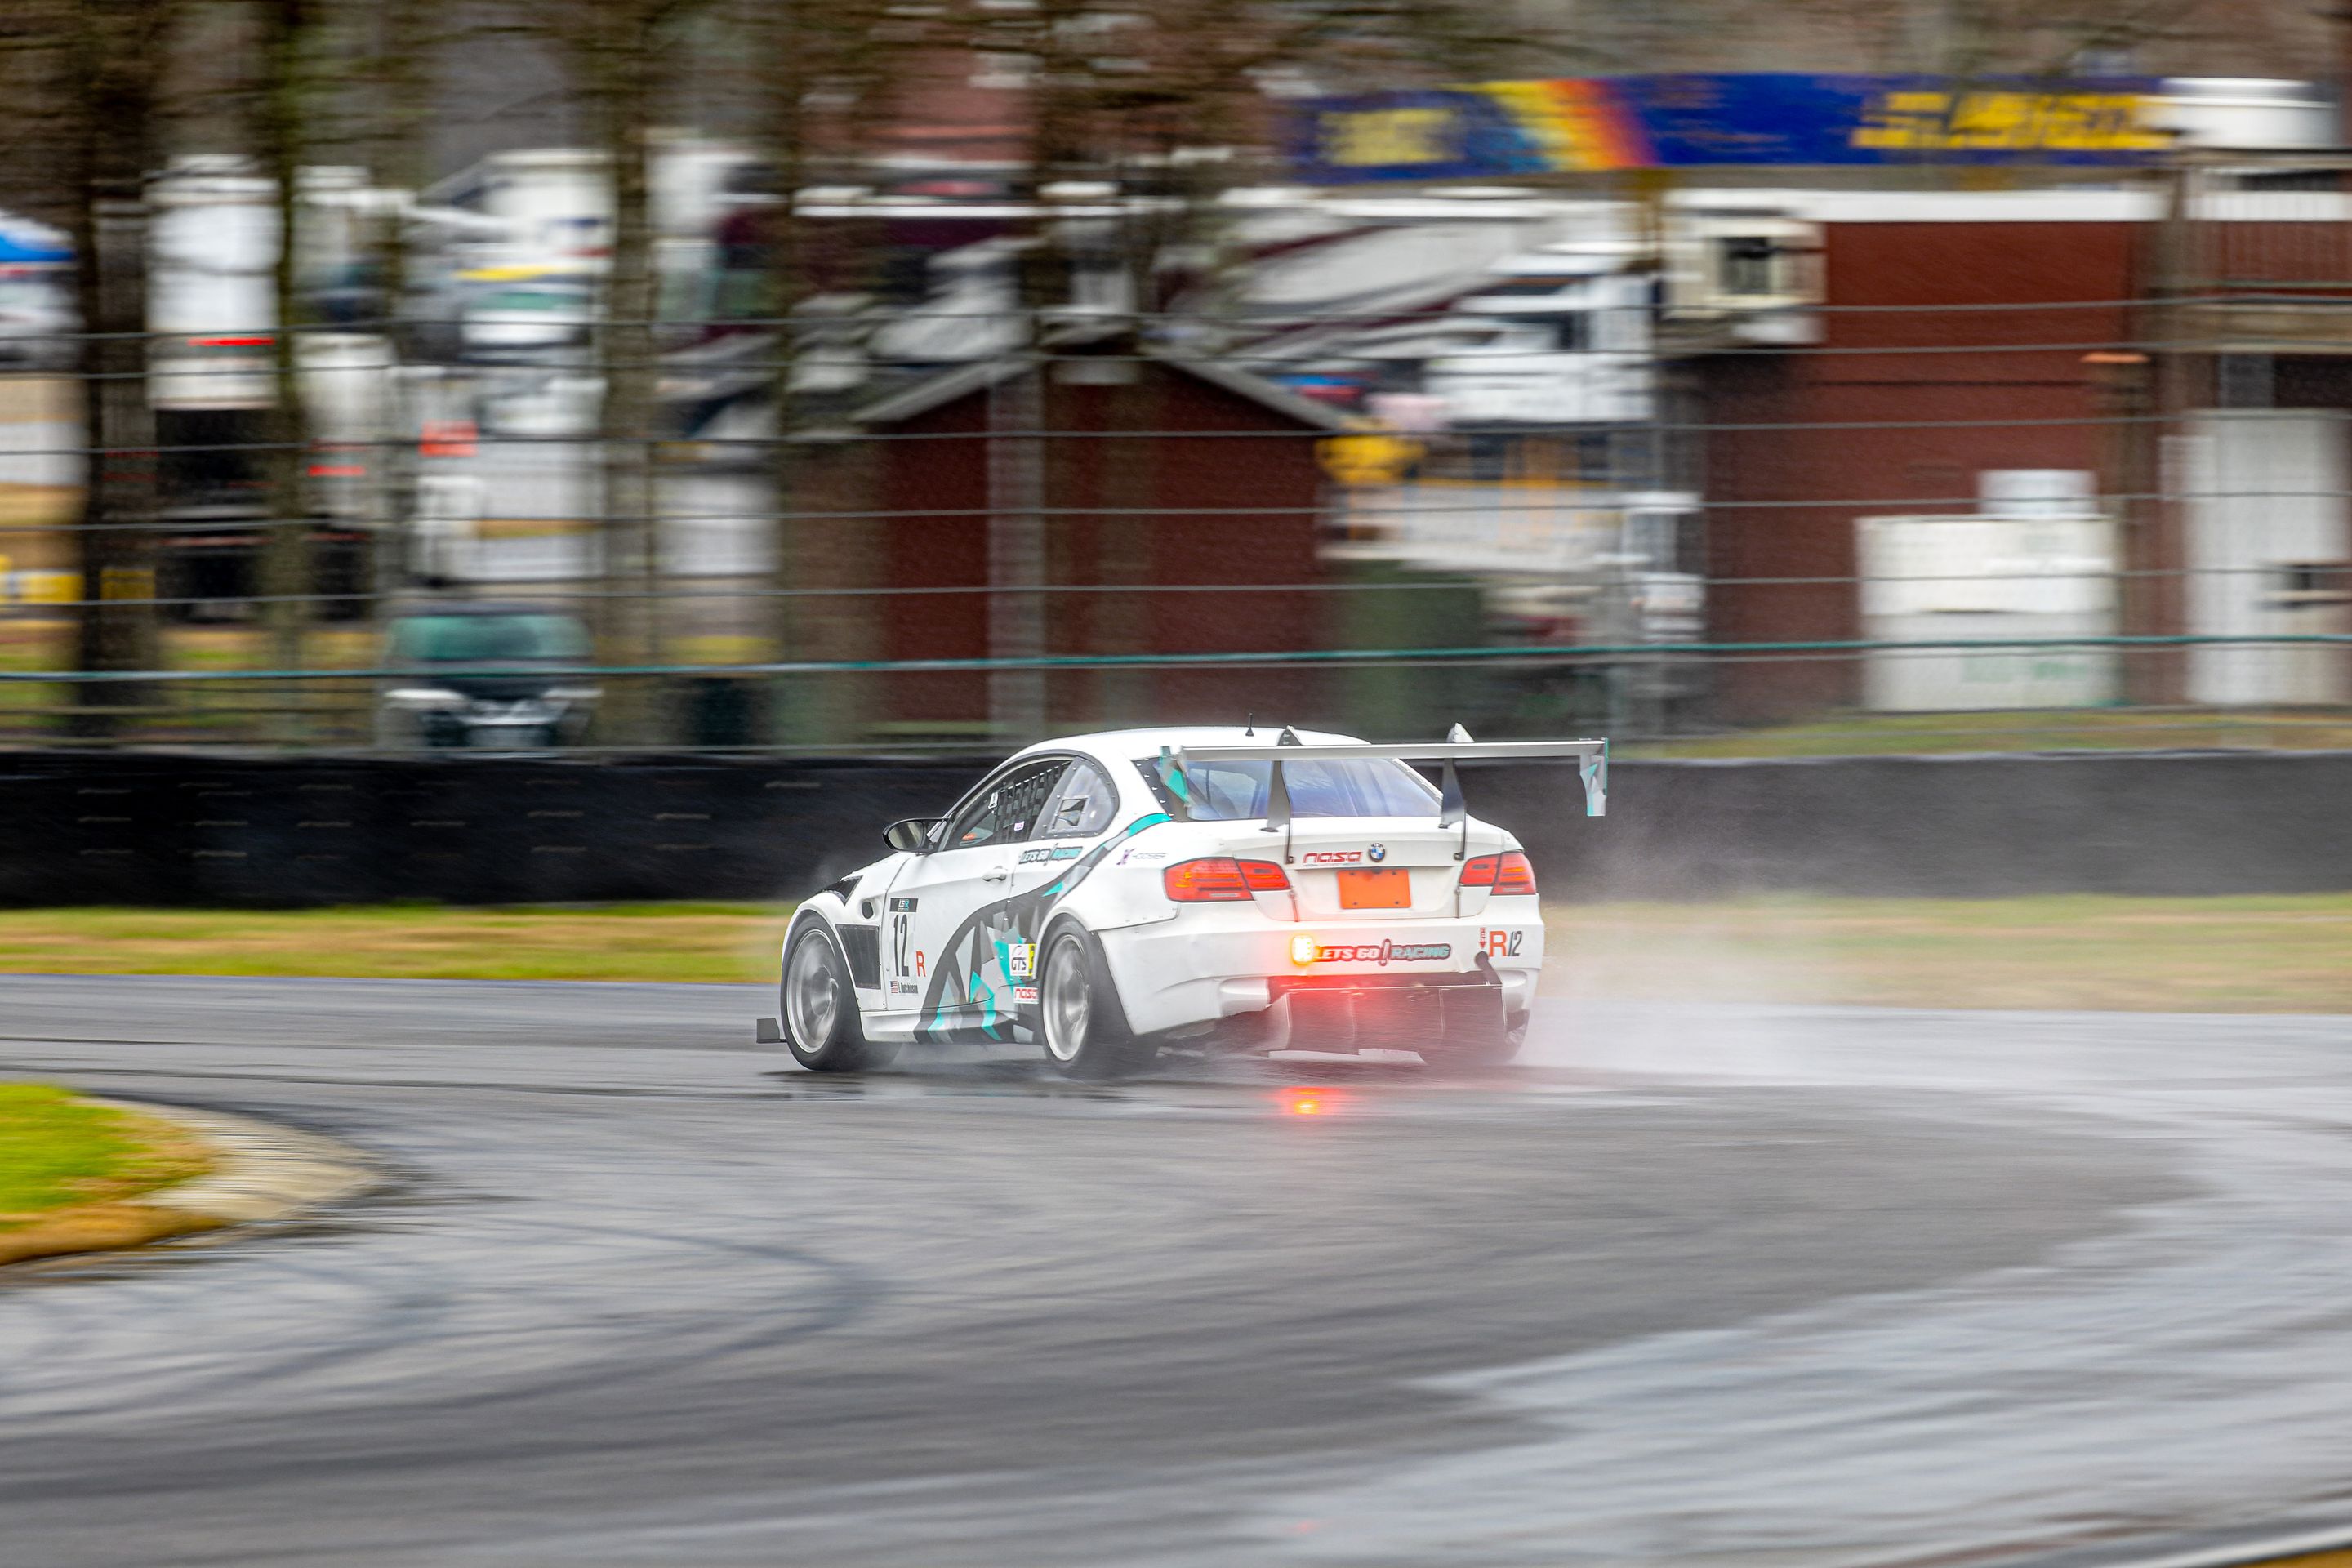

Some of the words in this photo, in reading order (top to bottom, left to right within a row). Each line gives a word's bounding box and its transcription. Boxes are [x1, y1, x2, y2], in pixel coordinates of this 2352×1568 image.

[1303, 852, 1361, 862] nasa
[893, 914, 909, 977] 12
[1314, 948, 1353, 960] LETS
[1392, 947, 1450, 959] RACING
[915, 951, 926, 977] R
[1012, 957, 1027, 970] GTS
